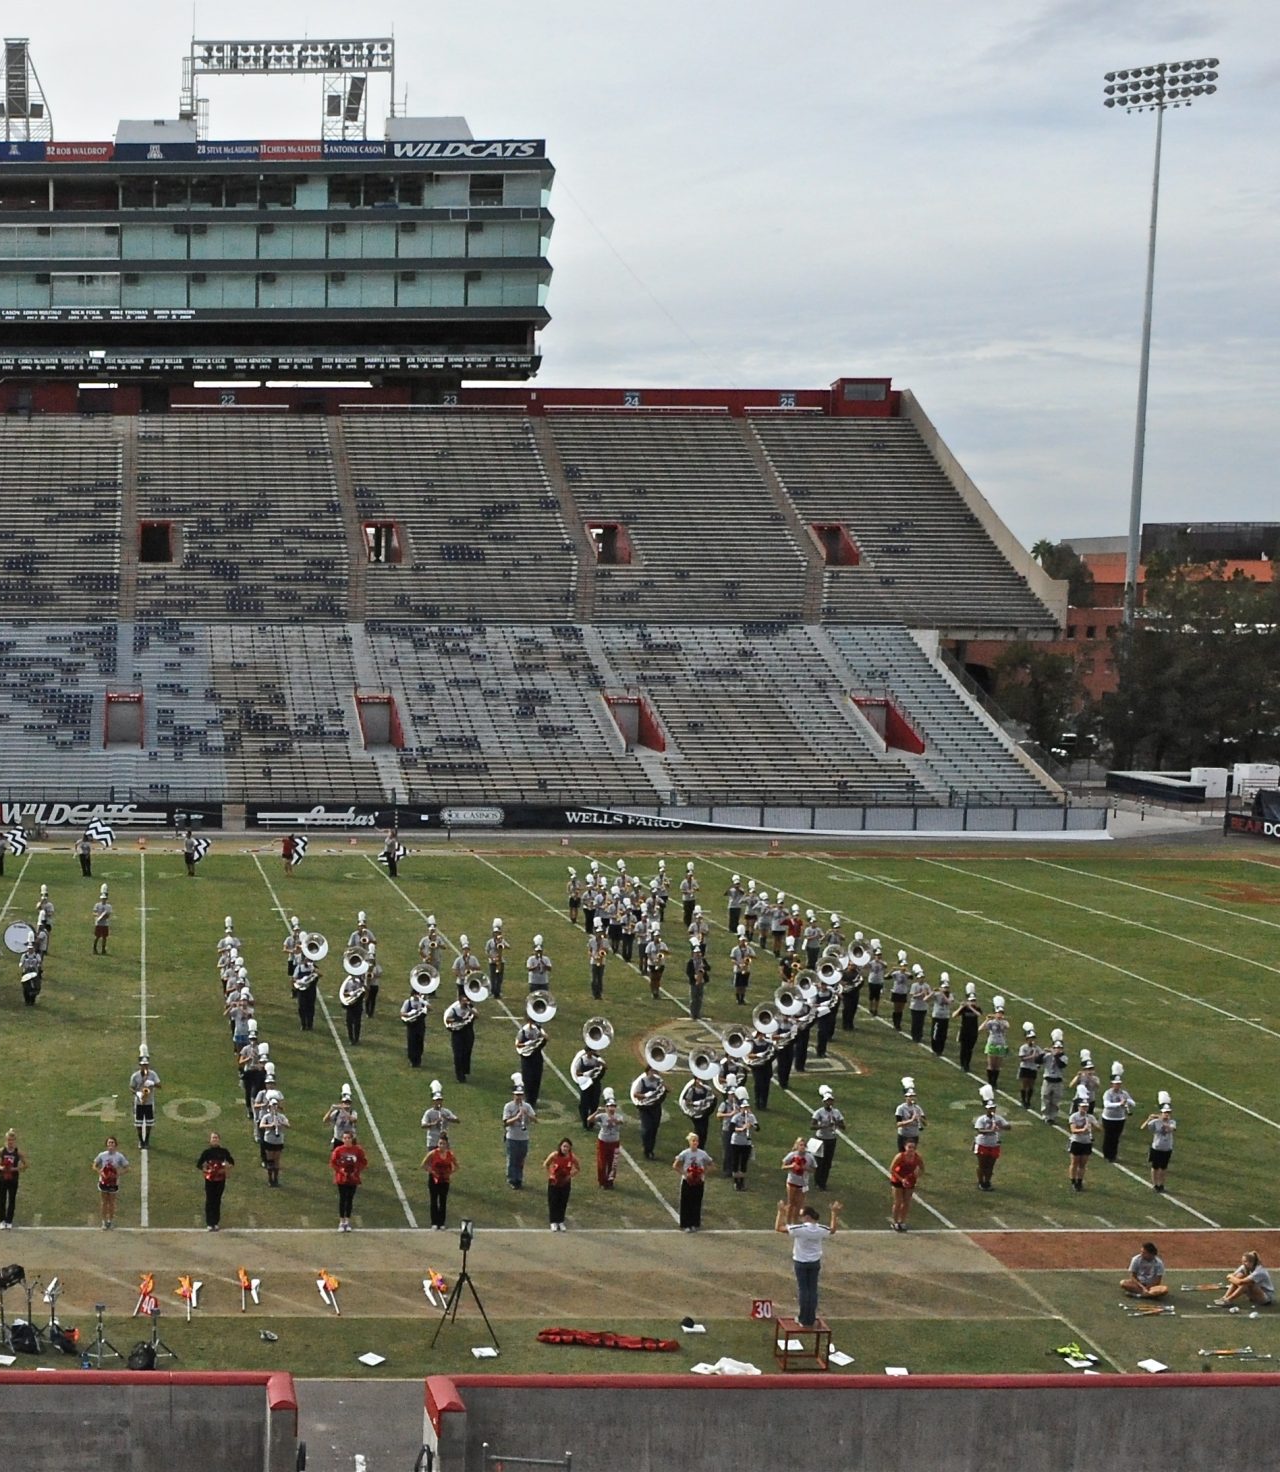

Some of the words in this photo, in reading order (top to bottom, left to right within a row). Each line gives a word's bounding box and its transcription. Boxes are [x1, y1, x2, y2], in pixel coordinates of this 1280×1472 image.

[324, 144, 328, 153] 5
[393, 142, 537, 158] WILDCATS
[222, 395, 235, 405] 22
[444, 396, 457, 405] 23
[625, 397, 638, 407] 24
[781, 398, 794, 408] 25
[566, 812, 623, 824] WELLS
[66, 1096, 222, 1122] 40
[142, 1296, 155, 1314] 40
[755, 1302, 772, 1318] 30
